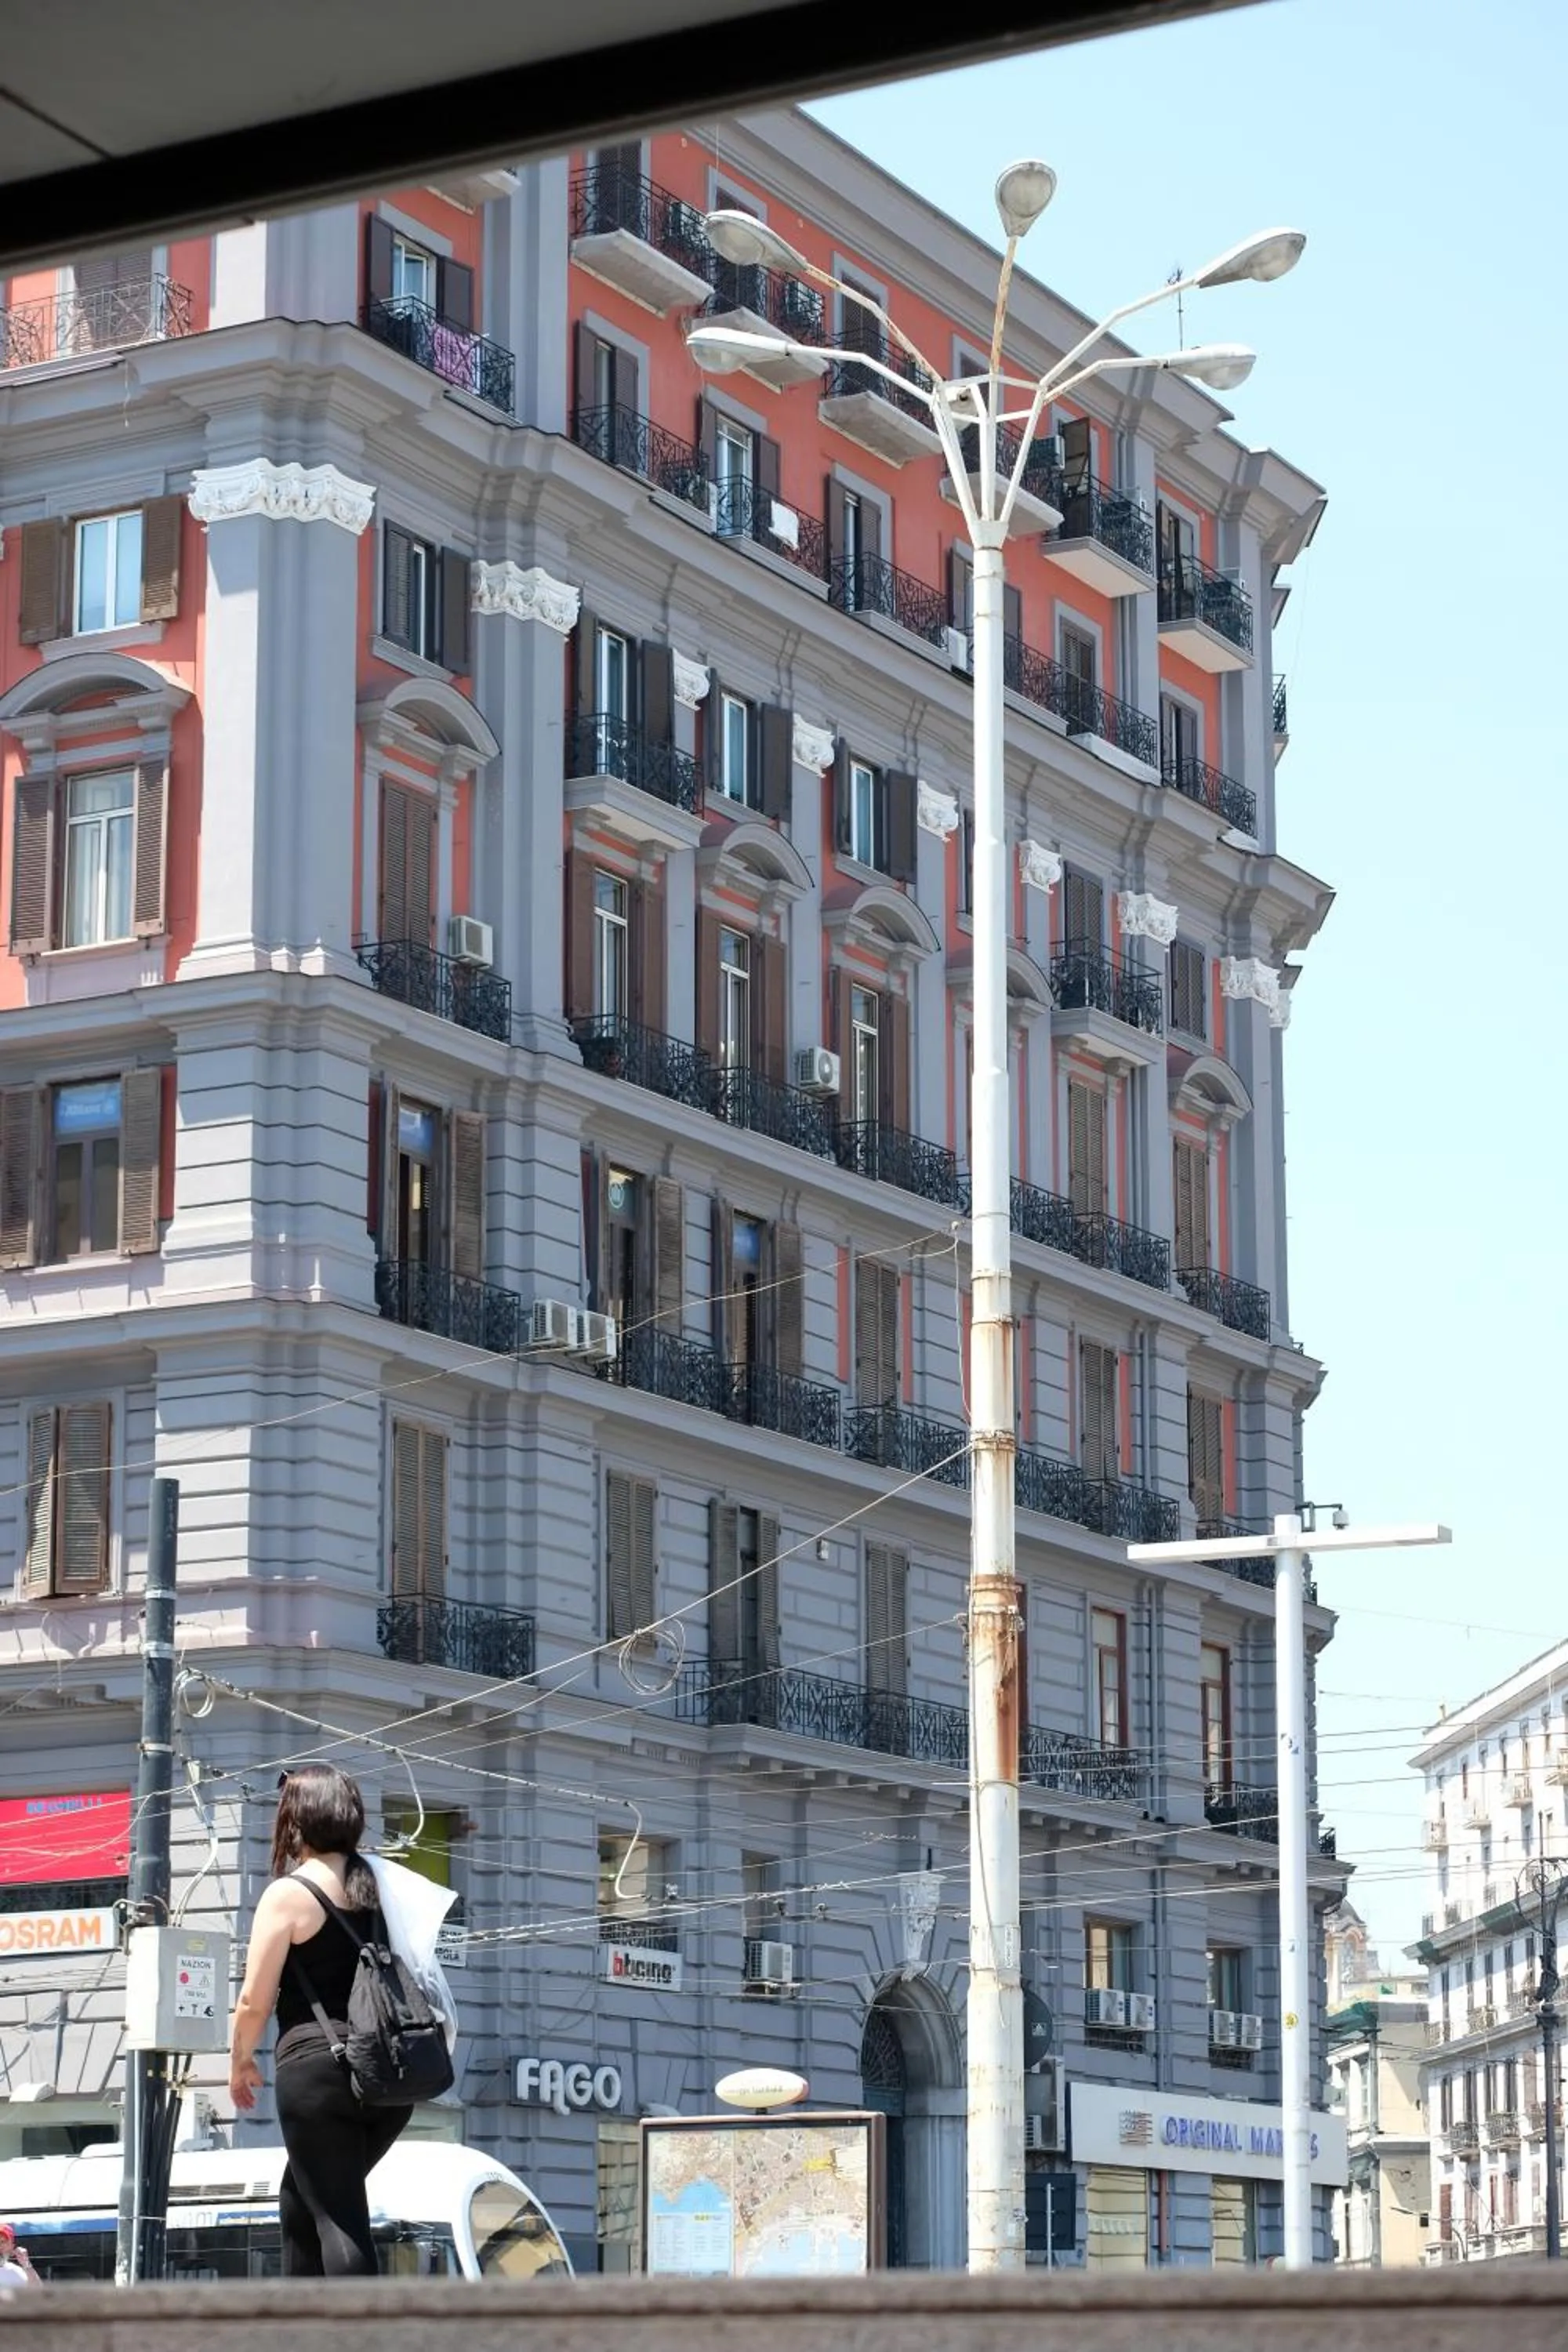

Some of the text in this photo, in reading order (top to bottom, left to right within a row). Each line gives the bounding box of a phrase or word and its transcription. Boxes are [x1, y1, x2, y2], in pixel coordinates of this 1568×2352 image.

[0, 1916, 101, 1951] OSRAM
[517, 2058, 621, 2115] FAGO
[1163, 2116, 1243, 2151] ORIGINAL
